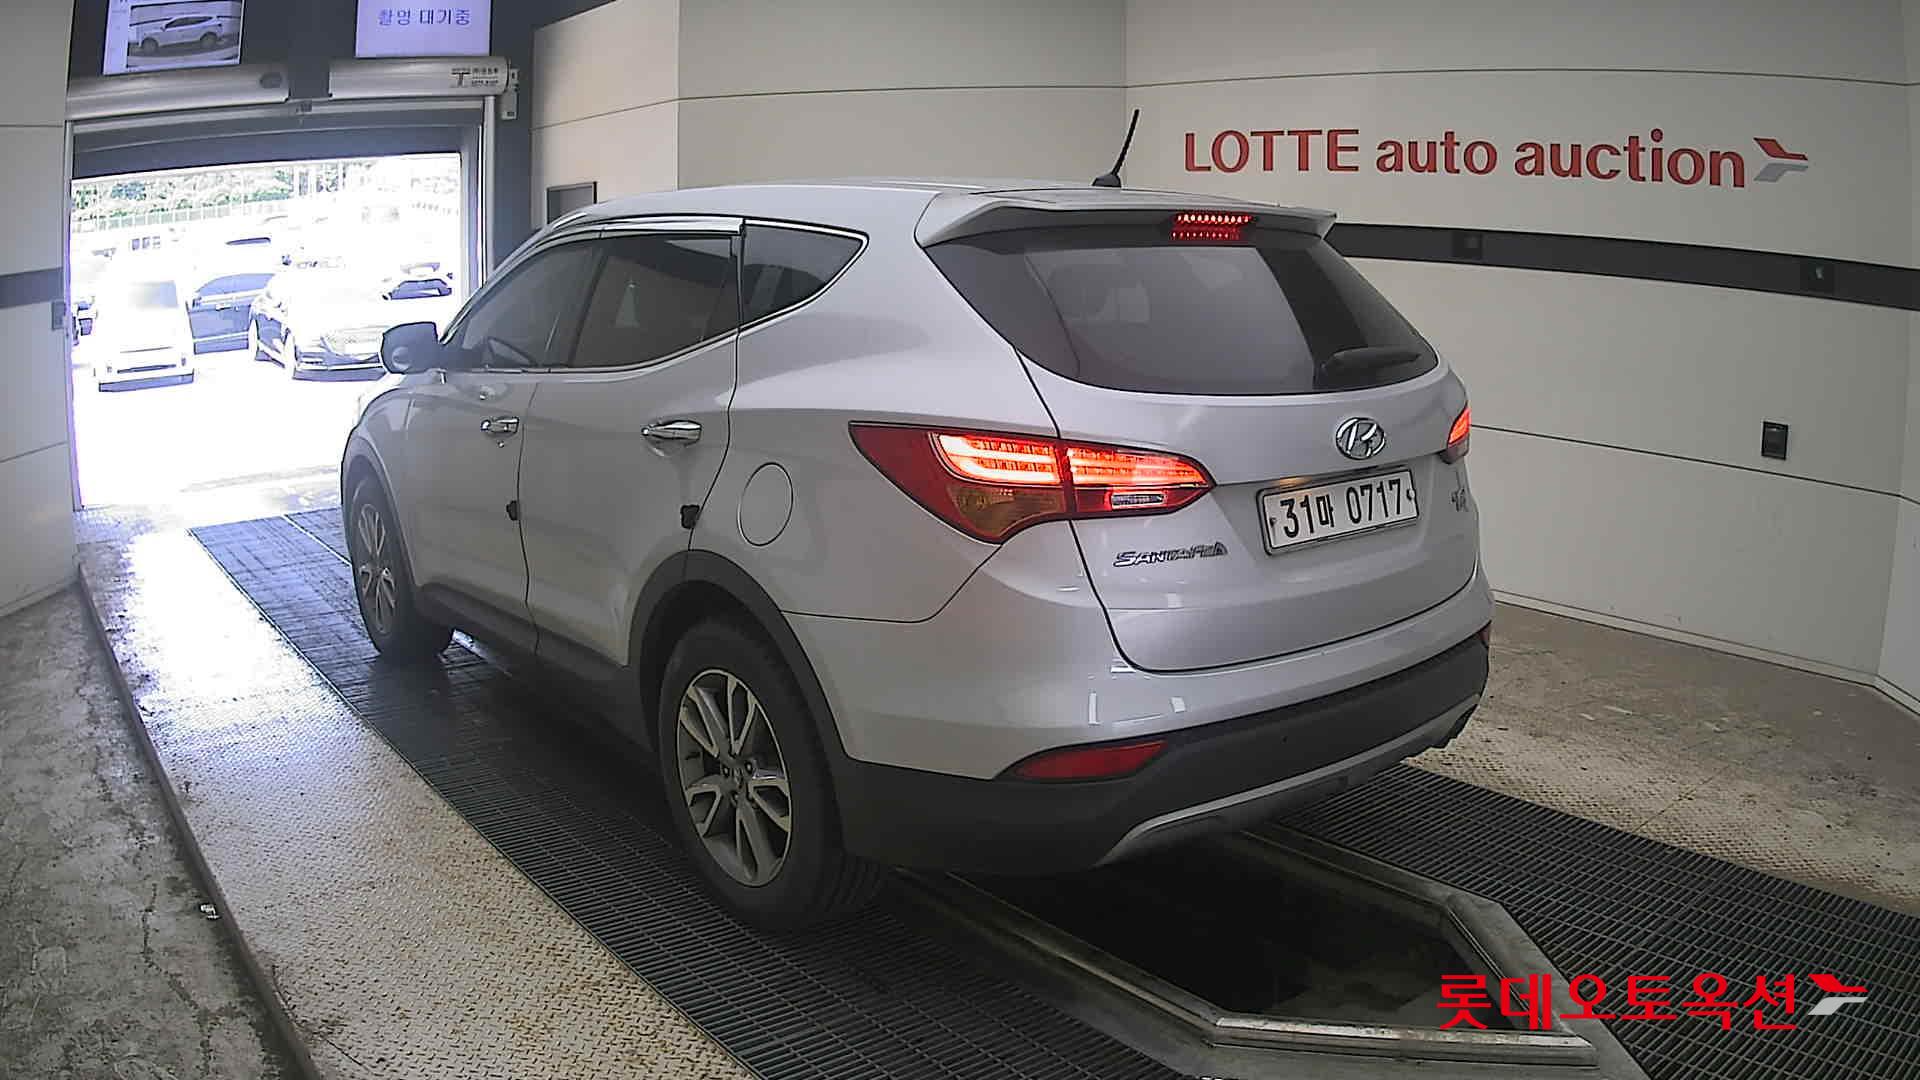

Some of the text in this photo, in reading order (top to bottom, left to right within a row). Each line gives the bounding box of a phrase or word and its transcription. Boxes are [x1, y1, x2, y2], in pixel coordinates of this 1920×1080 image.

[420, 8, 470, 26] 대기중
[1185, 128, 1745, 188] LOTTE auto auction
[1280, 494, 1334, 538] 31마
[1346, 478, 1401, 524] 0717
